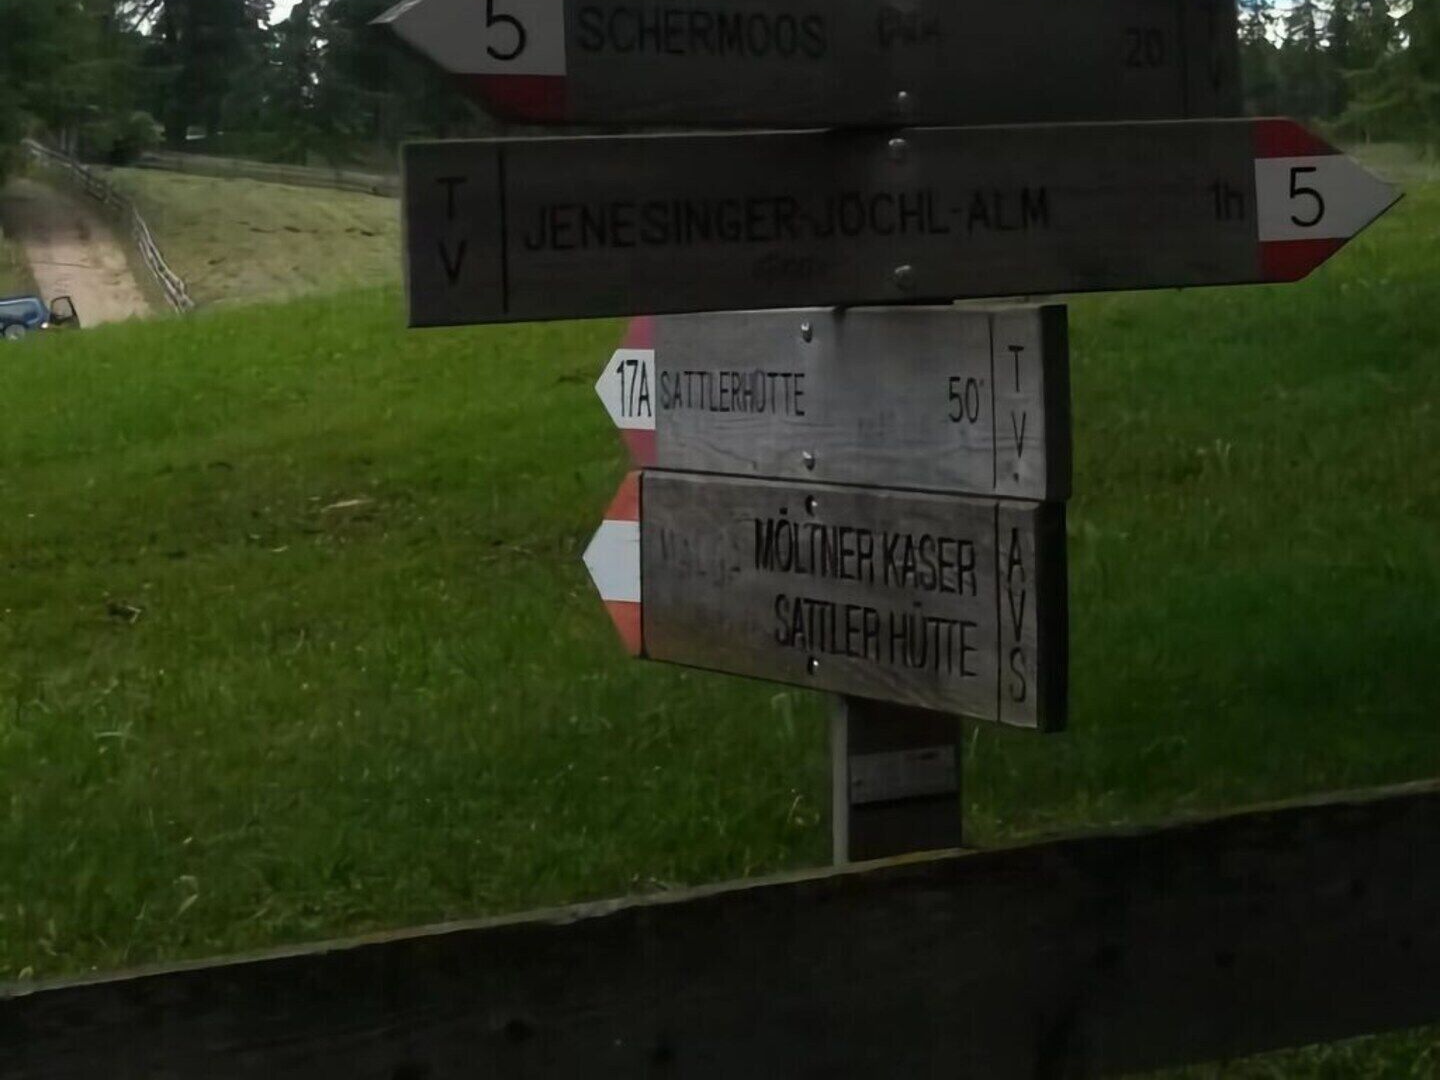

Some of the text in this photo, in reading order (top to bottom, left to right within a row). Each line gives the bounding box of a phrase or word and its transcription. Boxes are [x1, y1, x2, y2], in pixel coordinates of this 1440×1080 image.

[577, 5, 828, 59] SCHERMOOS
[1206, 180, 1246, 222] 1h
[1289, 166, 1326, 227] 5
[616, 359, 652, 419] 17A
[754, 507, 875, 583] MÖLTNER
[883, 531, 977, 597] KASER
[774, 593, 978, 678] SATTLER HÜTTE
